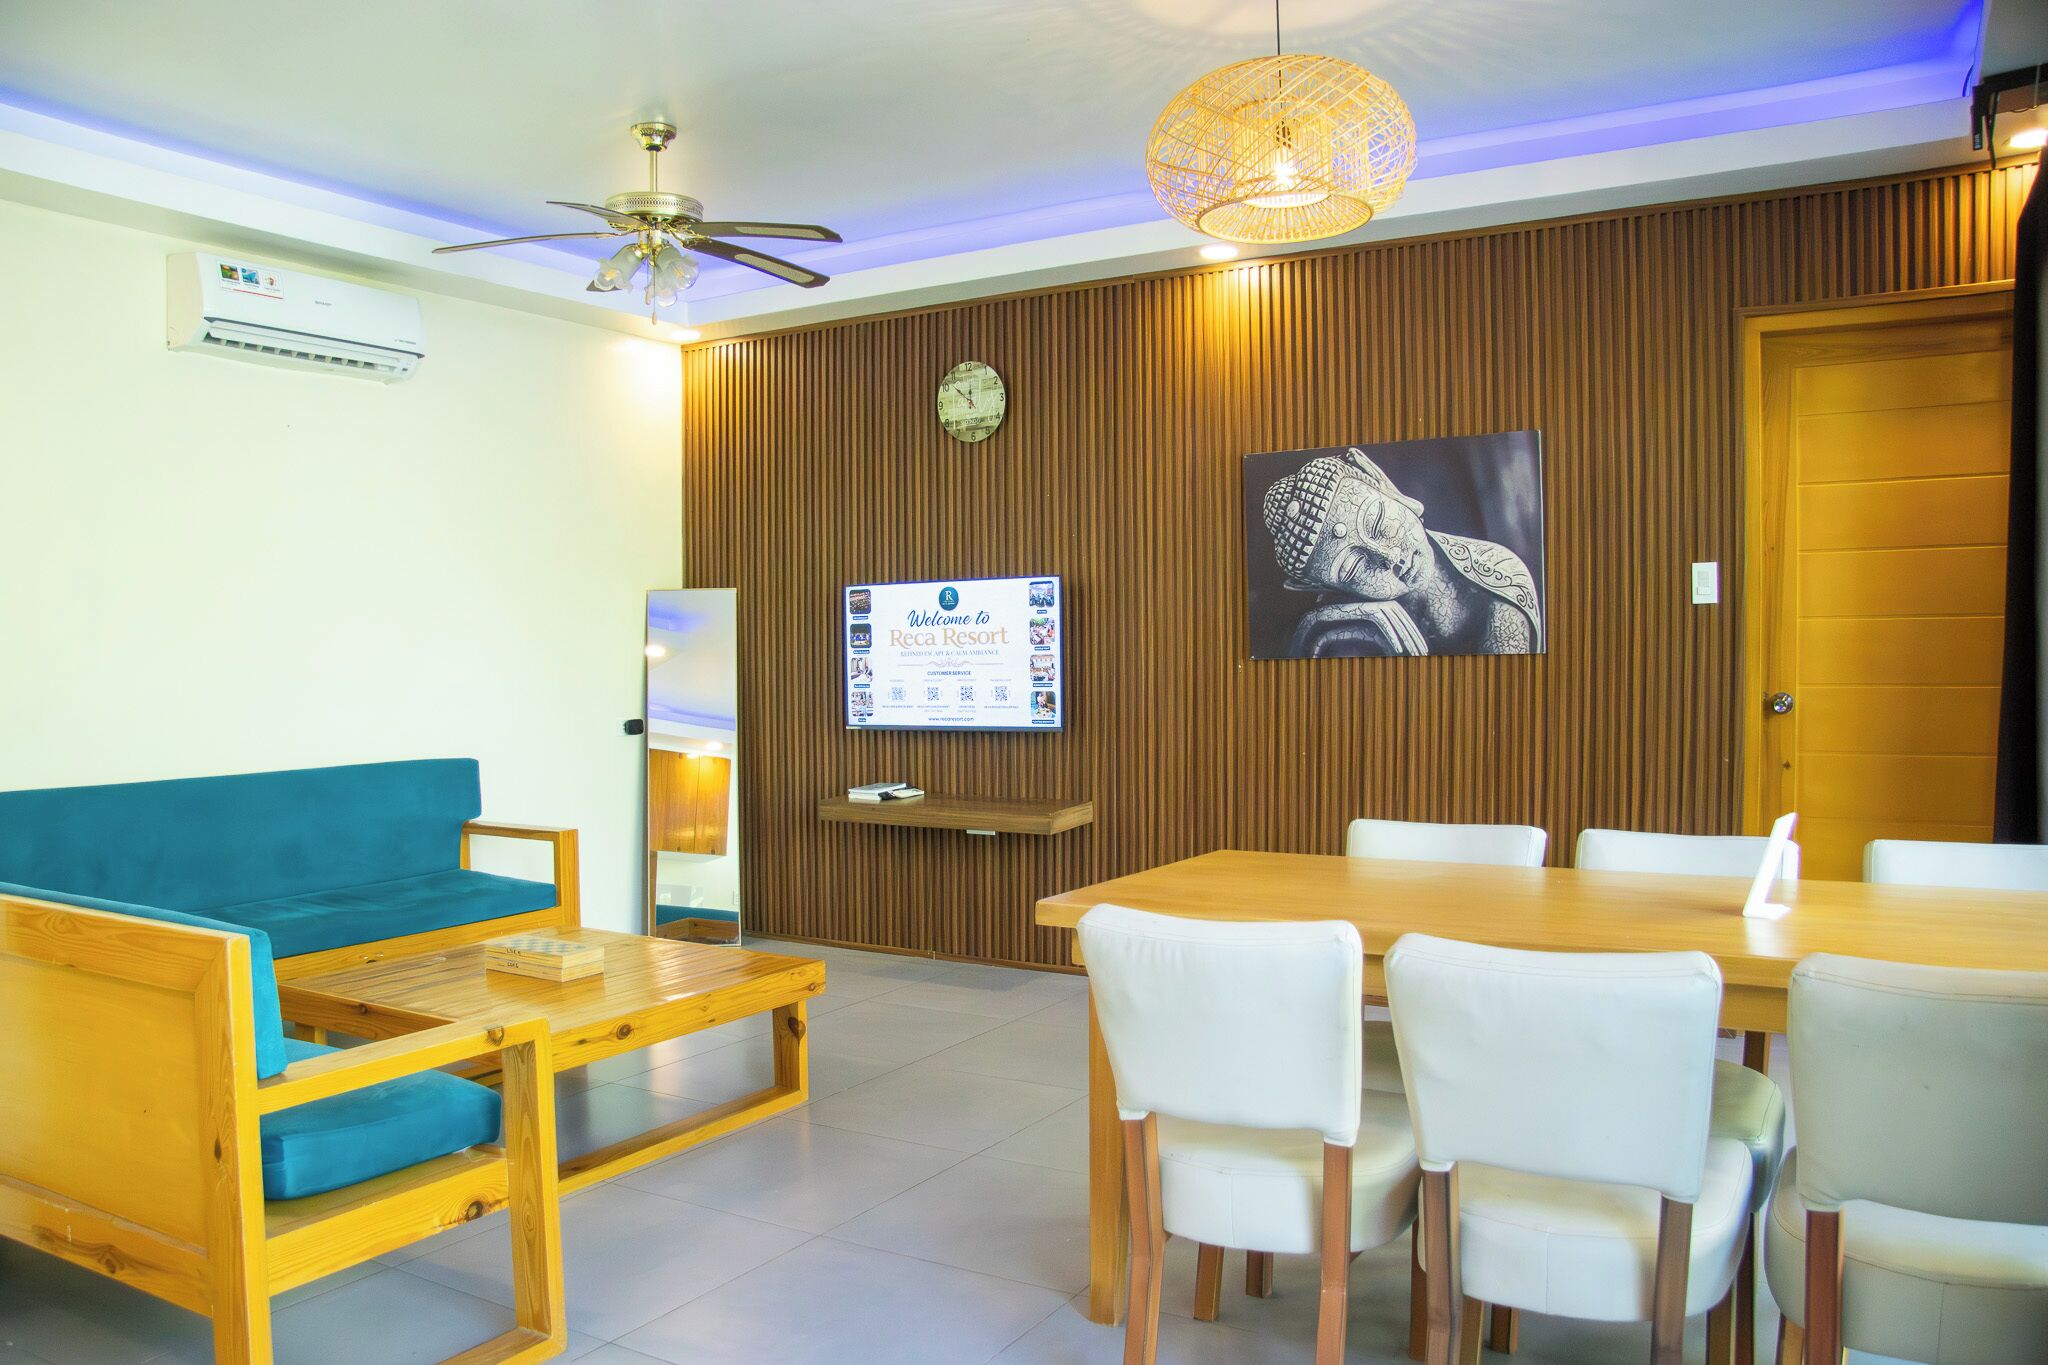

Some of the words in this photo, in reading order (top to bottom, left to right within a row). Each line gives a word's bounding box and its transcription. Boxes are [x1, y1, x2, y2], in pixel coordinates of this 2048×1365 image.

[965, 362, 972, 372] 12
[994, 376, 998, 385] 2
[942, 384, 949, 392] 10
[999, 393, 1004, 402] 3
[907, 610, 972, 627] Welcome
[976, 610, 990, 624] to
[888, 629, 936, 648] Reca
[942, 627, 1010, 648] Resort
